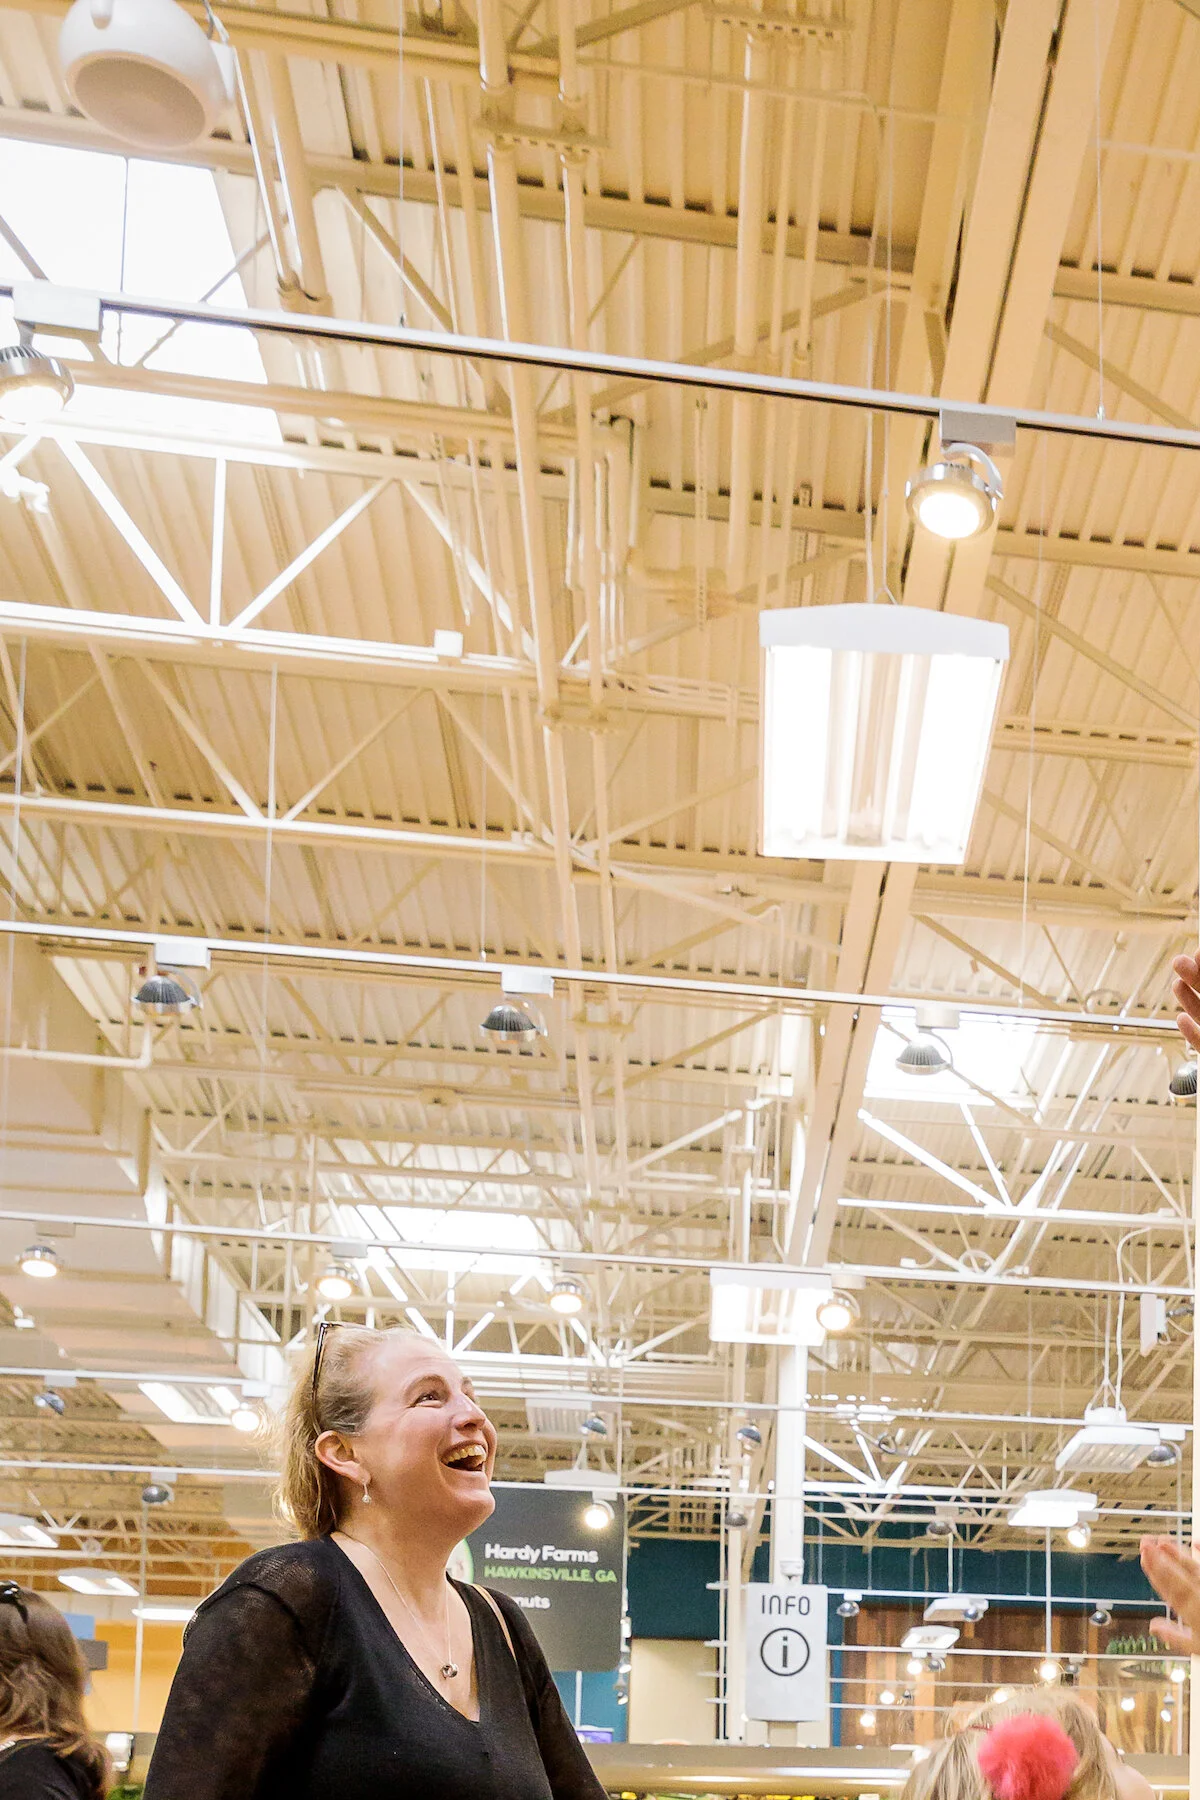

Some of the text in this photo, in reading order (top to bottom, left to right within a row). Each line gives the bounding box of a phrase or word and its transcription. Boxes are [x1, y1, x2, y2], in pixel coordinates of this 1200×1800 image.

[484, 1543, 598, 1564] Hardy Farms
[484, 1565, 617, 1583] HAWKINSVILLE, GA
[511, 1595, 551, 1609] nuts
[761, 1594, 811, 1616] INFO
